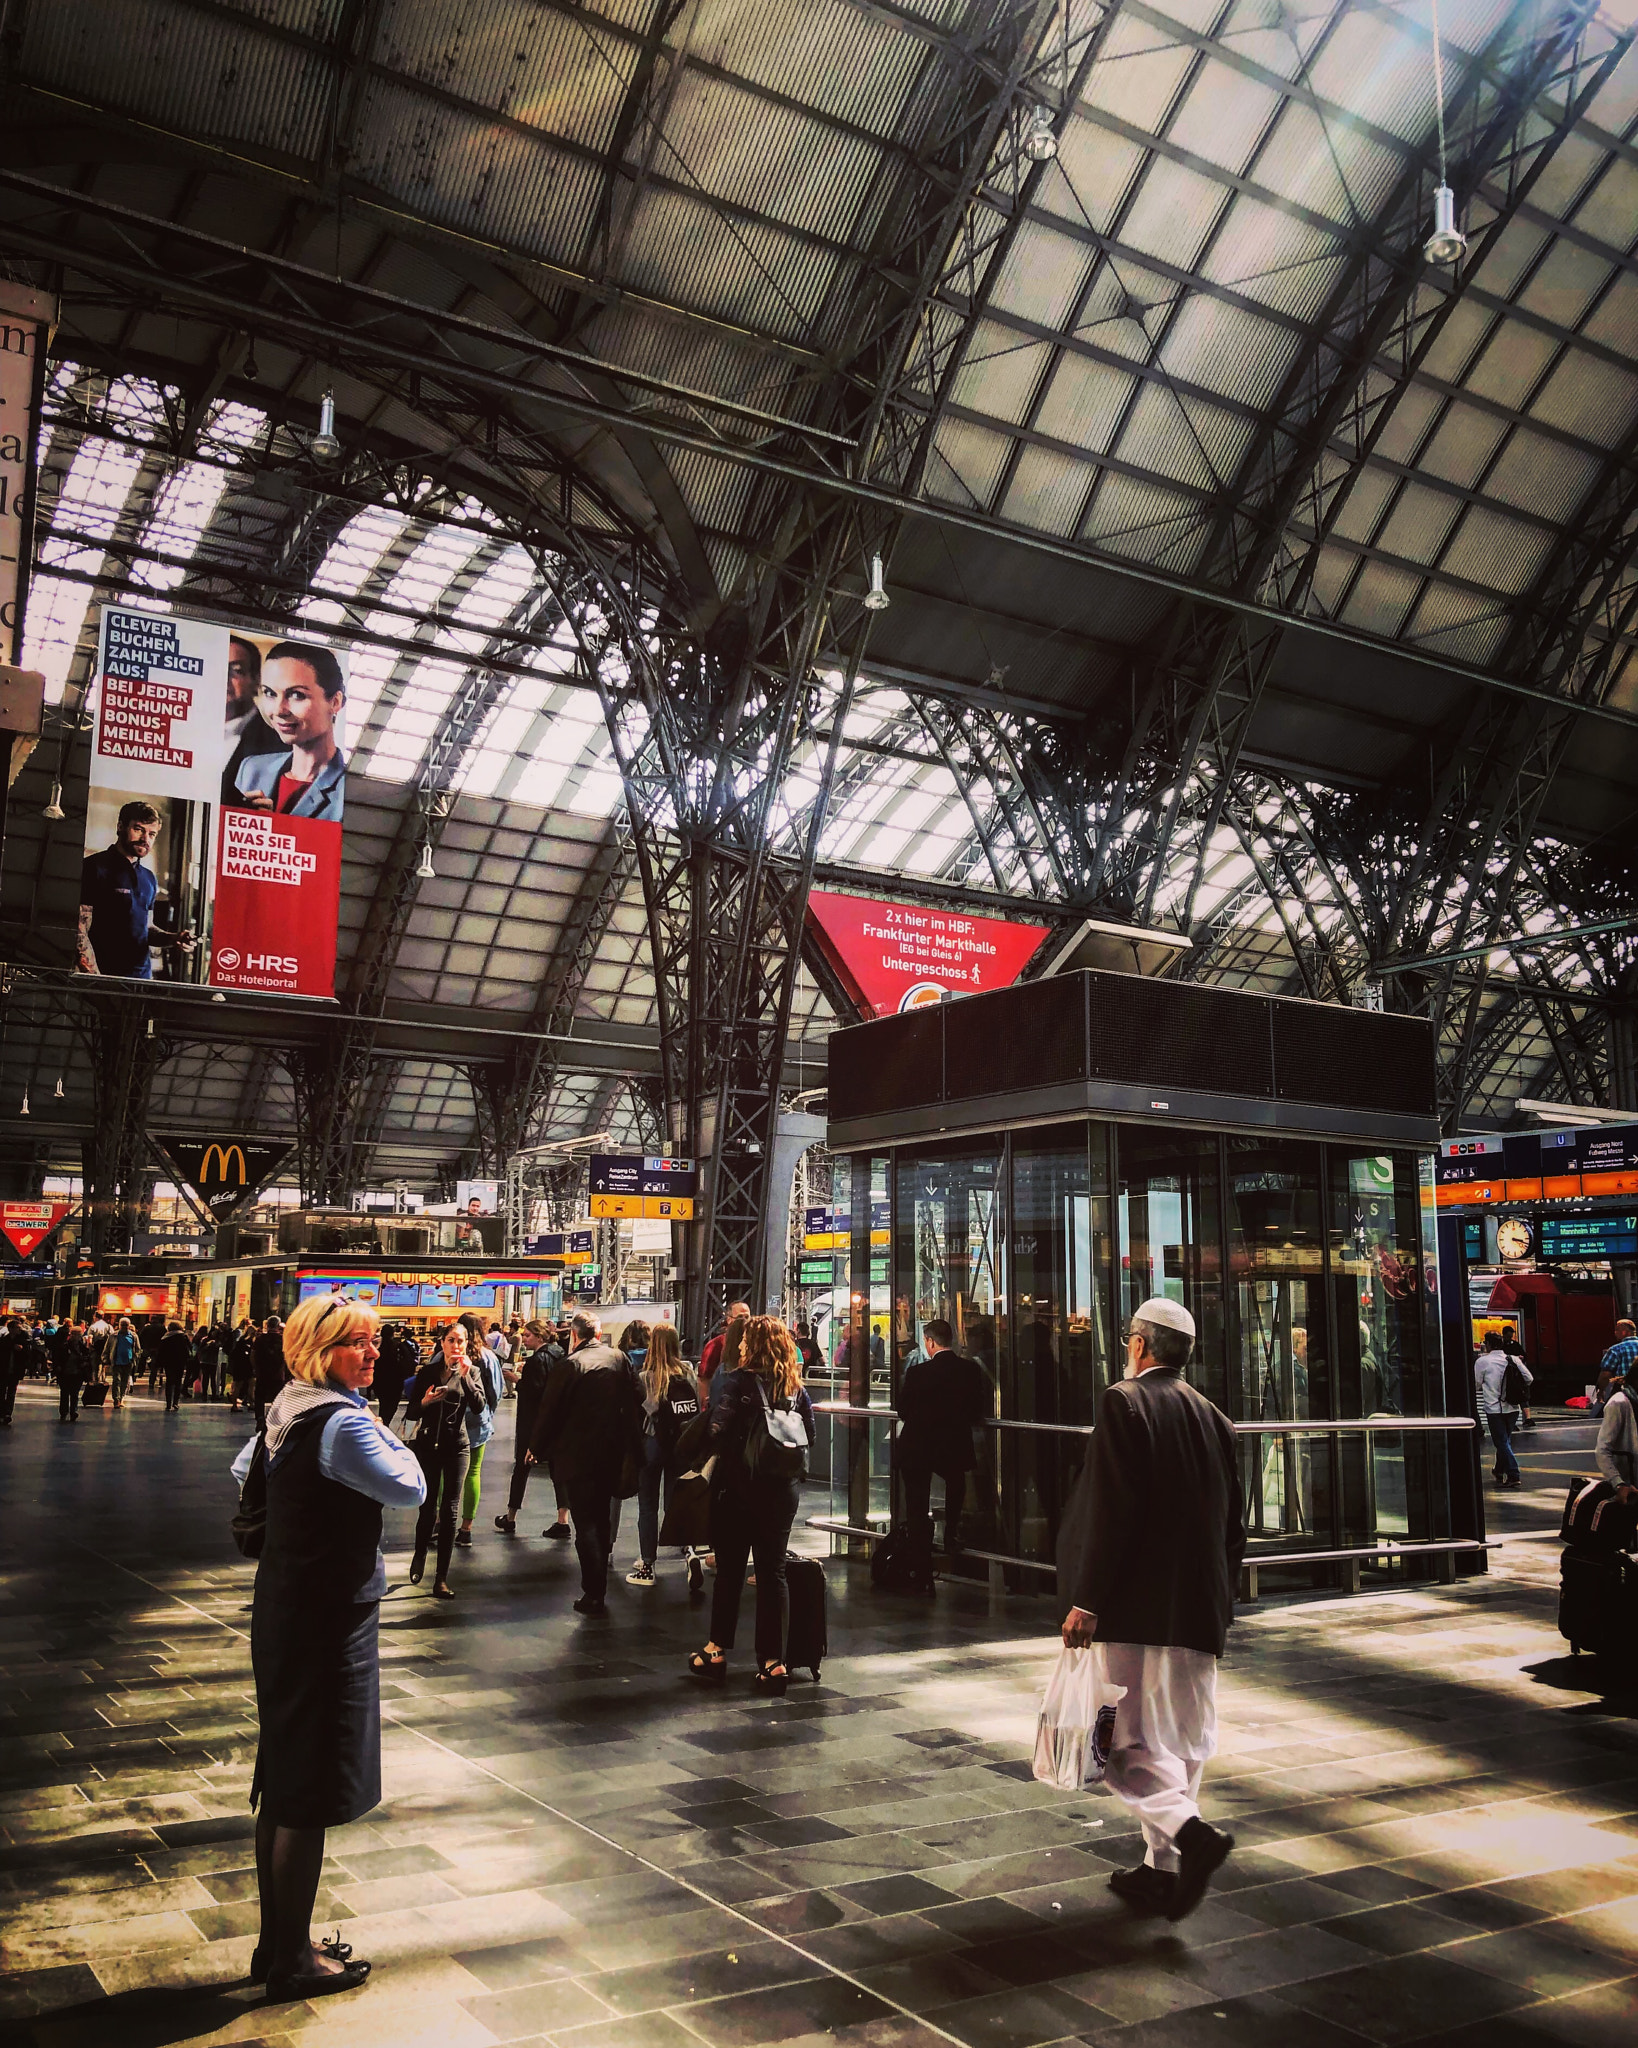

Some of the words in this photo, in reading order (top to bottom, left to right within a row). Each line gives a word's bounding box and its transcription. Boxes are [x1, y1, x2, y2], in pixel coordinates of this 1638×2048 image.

[111, 615, 172, 637] CLEVER
[110, 630, 176, 653] BUCHEN
[109, 645, 161, 666] ZAHLT
[164, 655, 199, 672] SICH
[107, 661, 145, 679] AUS:
[106, 677, 133, 694] BEI
[137, 681, 188, 703] JEDER
[106, 693, 184, 718] BUCHUNG
[104, 709, 167, 730] BONUS-
[103, 724, 165, 746] MEILEN
[102, 740, 189, 766] SAMMELN.
[228, 814, 268, 831] EGAL
[228, 830, 265, 846] WAS
[268, 836, 291, 850] SIE
[228, 846, 312, 869] BERUFLICH
[226, 861, 297, 882] MACHEN:
[905, 912, 928, 928] hier
[931, 916, 945, 931] im
[948, 919, 975, 935] HBF:
[863, 922, 933, 946] Frankfurter
[935, 934, 997, 955] Markthalle
[899, 942, 914, 954] (EG
[916, 945, 930, 957] bei
[931, 948, 953, 960] Gleis
[954, 951, 962, 962] 6)
[246, 953, 299, 974] HRS
[882, 955, 968, 980] Untergeschoss
[216, 971, 236, 983] Das
[239, 974, 297, 989] Hotelportal
[1557, 1135, 1565, 1145] U
[608, 1167, 628, 1175] Ausgang
[653, 1160, 660, 1169] U
[1370, 1202, 1379, 1216] S
[1560, 1227, 1589, 1235] Mannheim
[1625, 1216, 1637, 1229] 17
[582, 1276, 595, 1289] 13
[671, 1399, 698, 1414] VANS
